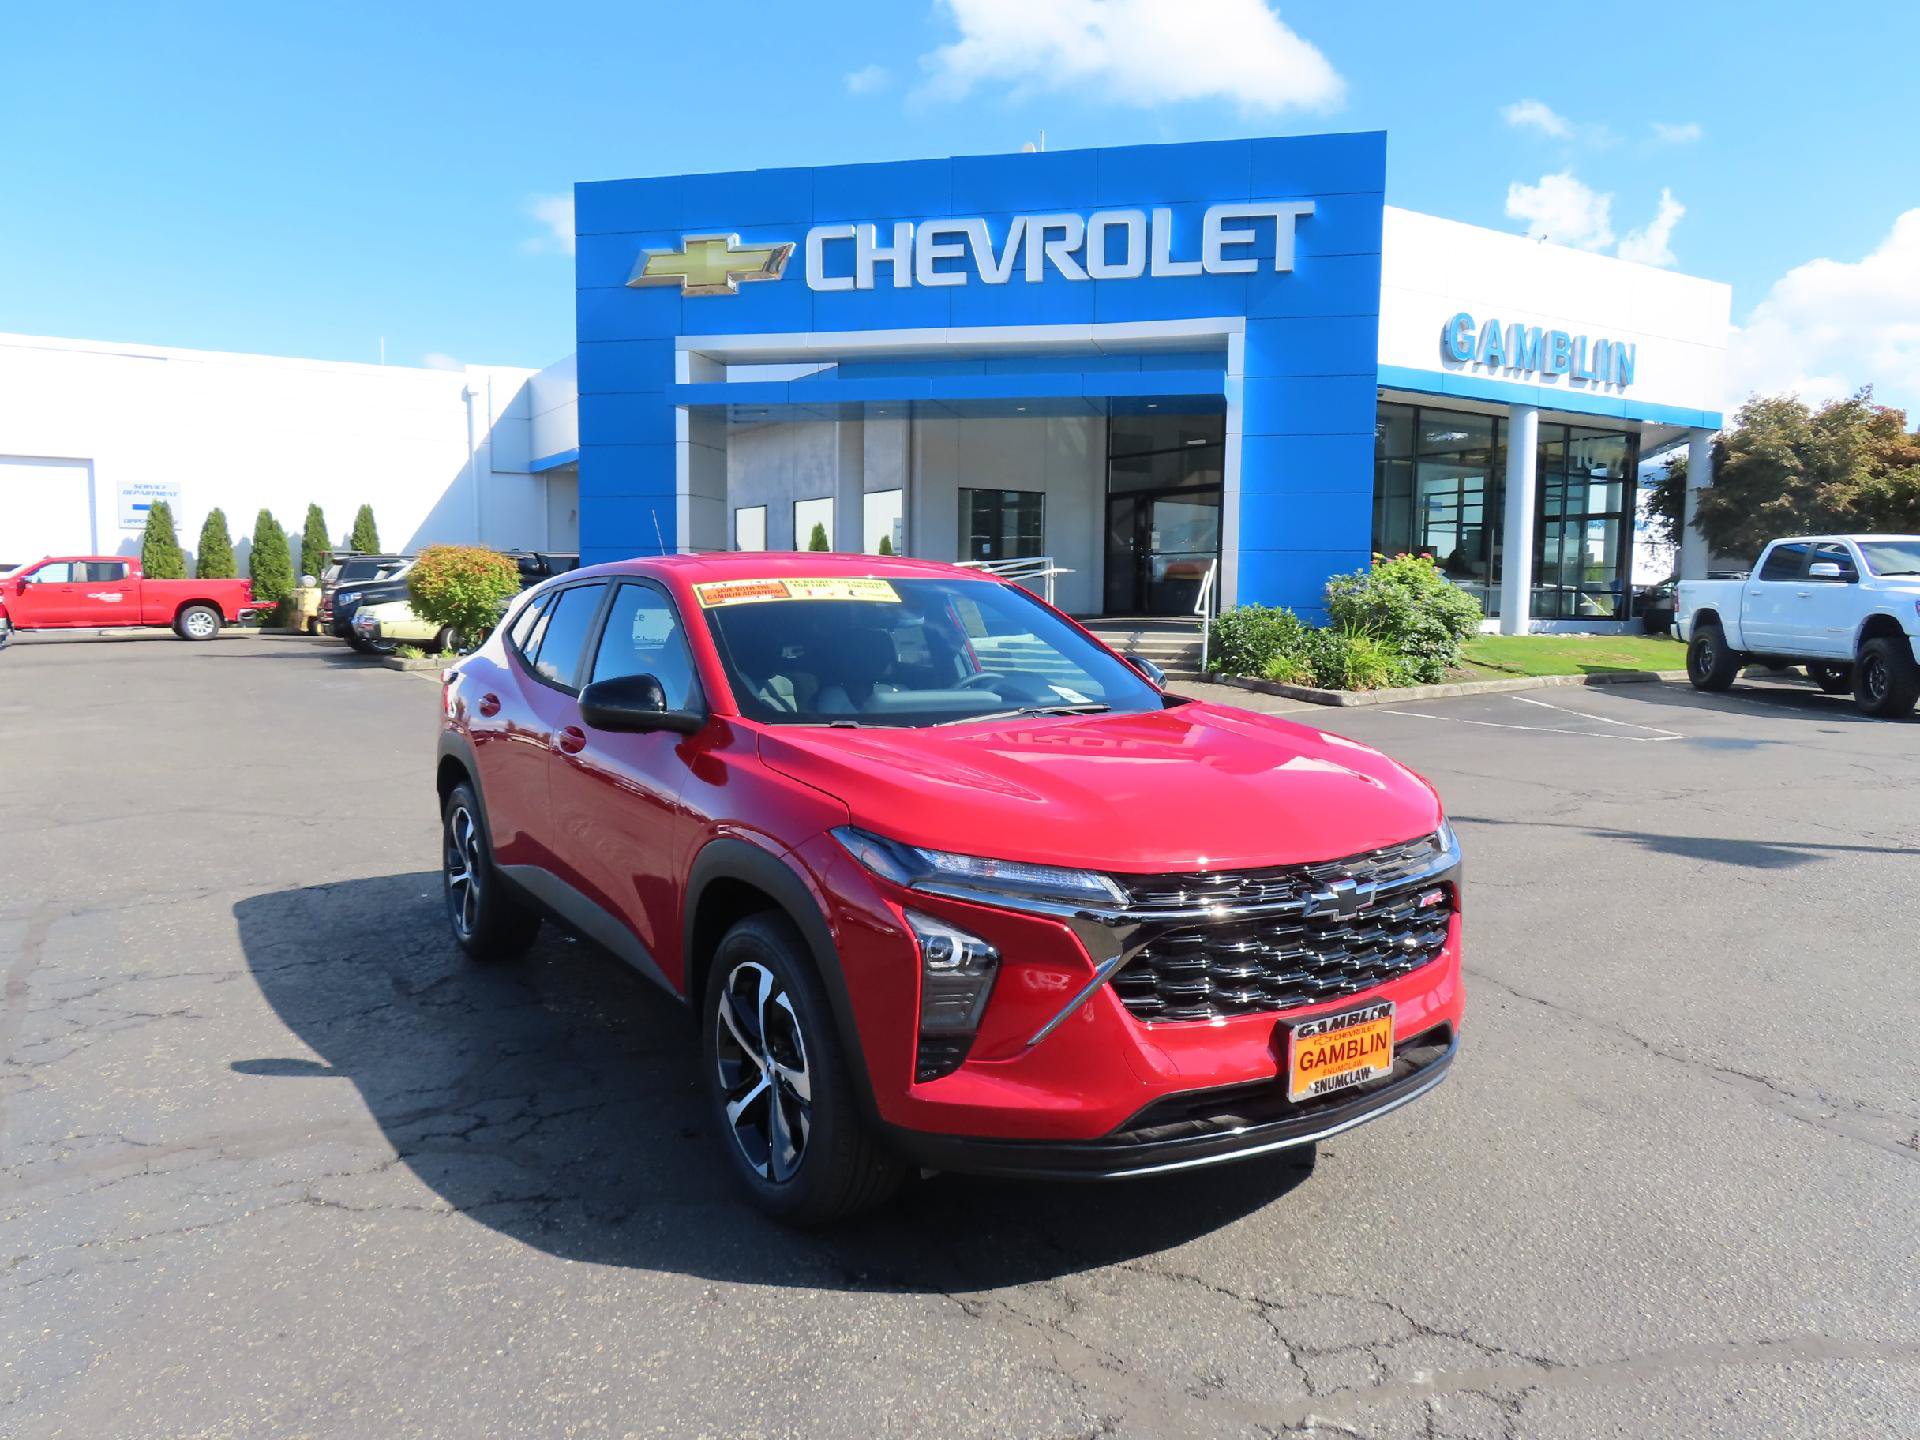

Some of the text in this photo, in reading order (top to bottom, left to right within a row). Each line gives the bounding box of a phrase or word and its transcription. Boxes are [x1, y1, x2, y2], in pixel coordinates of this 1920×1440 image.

[805, 200, 1316, 291] CHEVROLET
[1440, 312, 1636, 387] GAMBLIN
[1297, 1003, 1393, 1038] GAMBLIN
[1333, 1024, 1377, 1042] CHEVROLET
[1300, 1030, 1387, 1071] GAMBLIN
[1322, 1059, 1364, 1076] ENUMCLAW
[1313, 1066, 1371, 1094] ENUMCLAW
